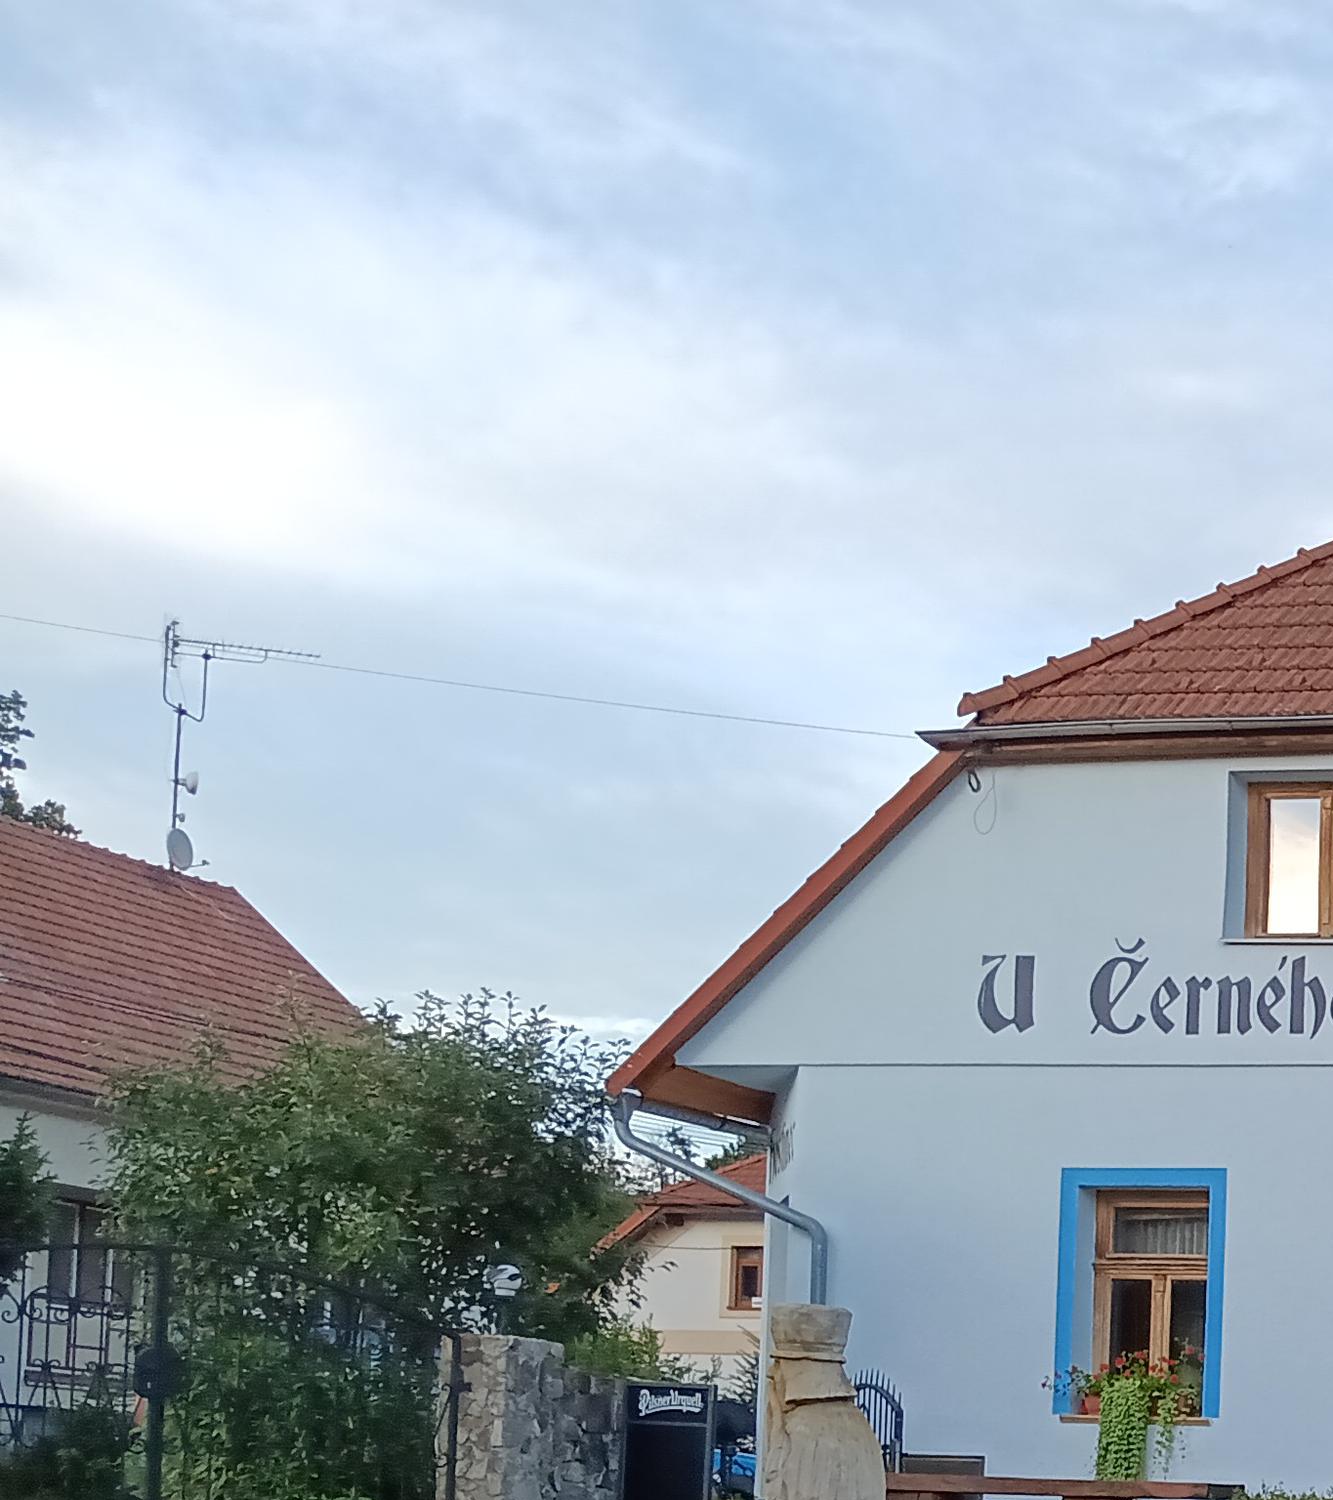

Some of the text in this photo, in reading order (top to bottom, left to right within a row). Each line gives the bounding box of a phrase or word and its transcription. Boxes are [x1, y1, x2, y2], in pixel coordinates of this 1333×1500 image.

[977, 953, 1036, 1034] U
[638, 1389, 703, 1416] Pilsner Urquell
